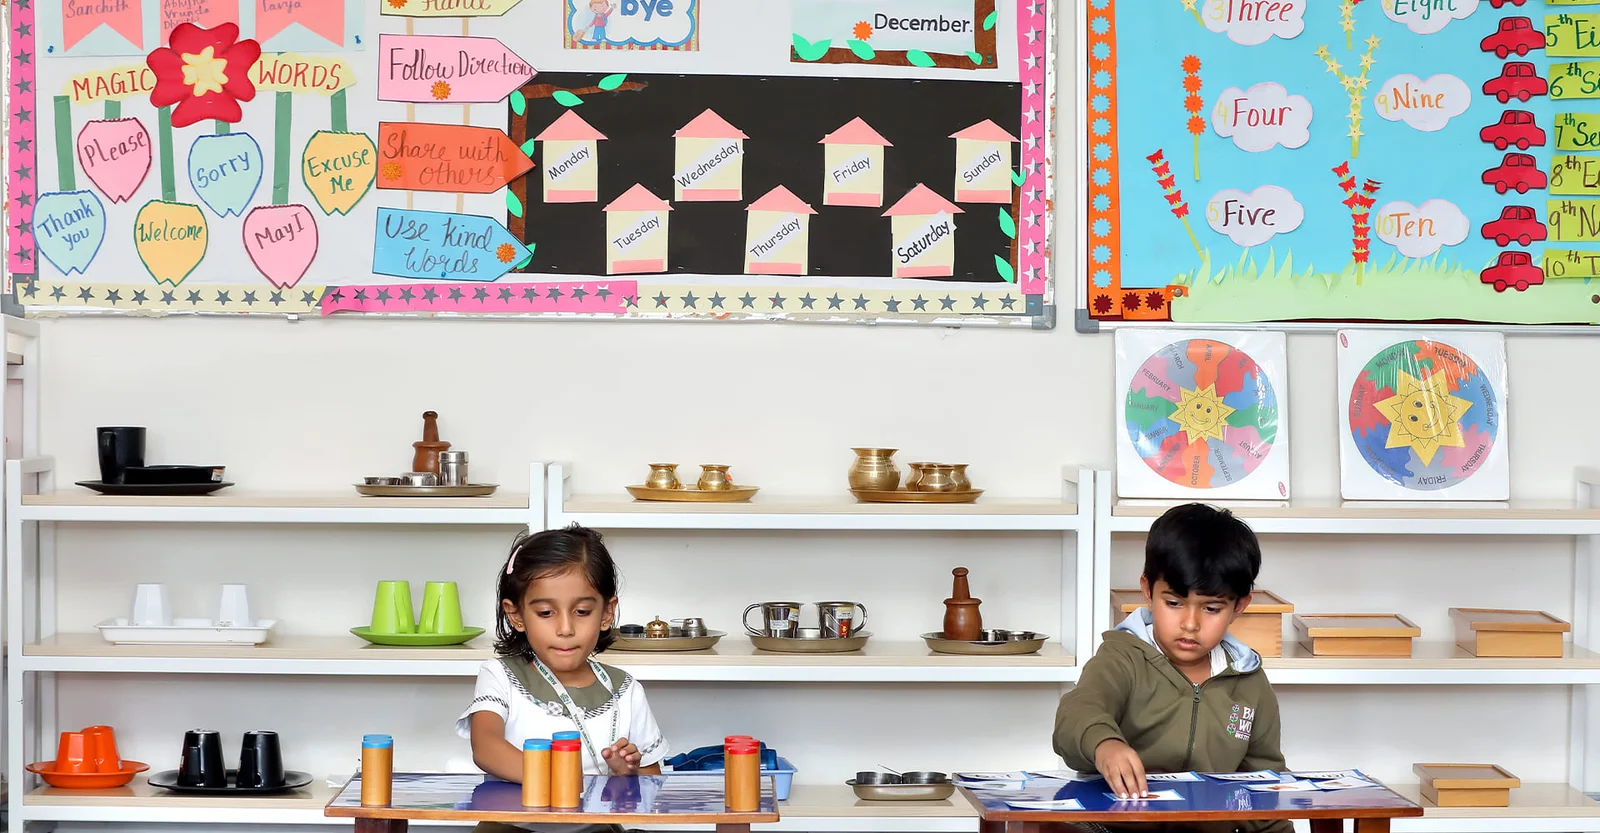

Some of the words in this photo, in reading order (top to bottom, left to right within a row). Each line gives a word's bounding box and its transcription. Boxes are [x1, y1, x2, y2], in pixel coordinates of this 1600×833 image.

[621, 0, 673, 21] bye
[390, 48, 453, 81] Follow
[72, 68, 155, 101] MAGIC
[258, 59, 342, 91] WORDS
[1392, 82, 1445, 111] Nine
[1232, 98, 1292, 127] Four
[83, 130, 148, 168] Please
[383, 130, 451, 162] Share
[459, 136, 508, 163] with
[196, 150, 251, 189] Sorry
[307, 148, 371, 177] Excuse
[419, 162, 498, 186] others
[548, 146, 591, 180] Monday
[677, 141, 741, 189] Wednesday
[832, 156, 871, 183] Friday
[962, 149, 1002, 184] Sunday
[330, 175, 354, 195] Me
[37, 198, 95, 238] Thank
[385, 214, 431, 242] Use
[1222, 199, 1276, 227] Five
[1389, 212, 1437, 238] Ten
[138, 220, 204, 243] Welcome
[613, 216, 661, 250] Tuesday
[750, 217, 801, 259] Thursday
[897, 219, 950, 264] Saturday
[404, 246, 479, 274] Words
[1141, 368, 1172, 393] FEBRUARY
[1479, 383, 1494, 426] WEDNESDAY
[1213, 448, 1233, 482] SEPTEMBER
[1238, 440, 1263, 460] AUUST
[1461, 443, 1487, 473] THURSDAY
[1190, 455, 1200, 486] OCTOBER
[1417, 474, 1447, 486] FRIDAY
